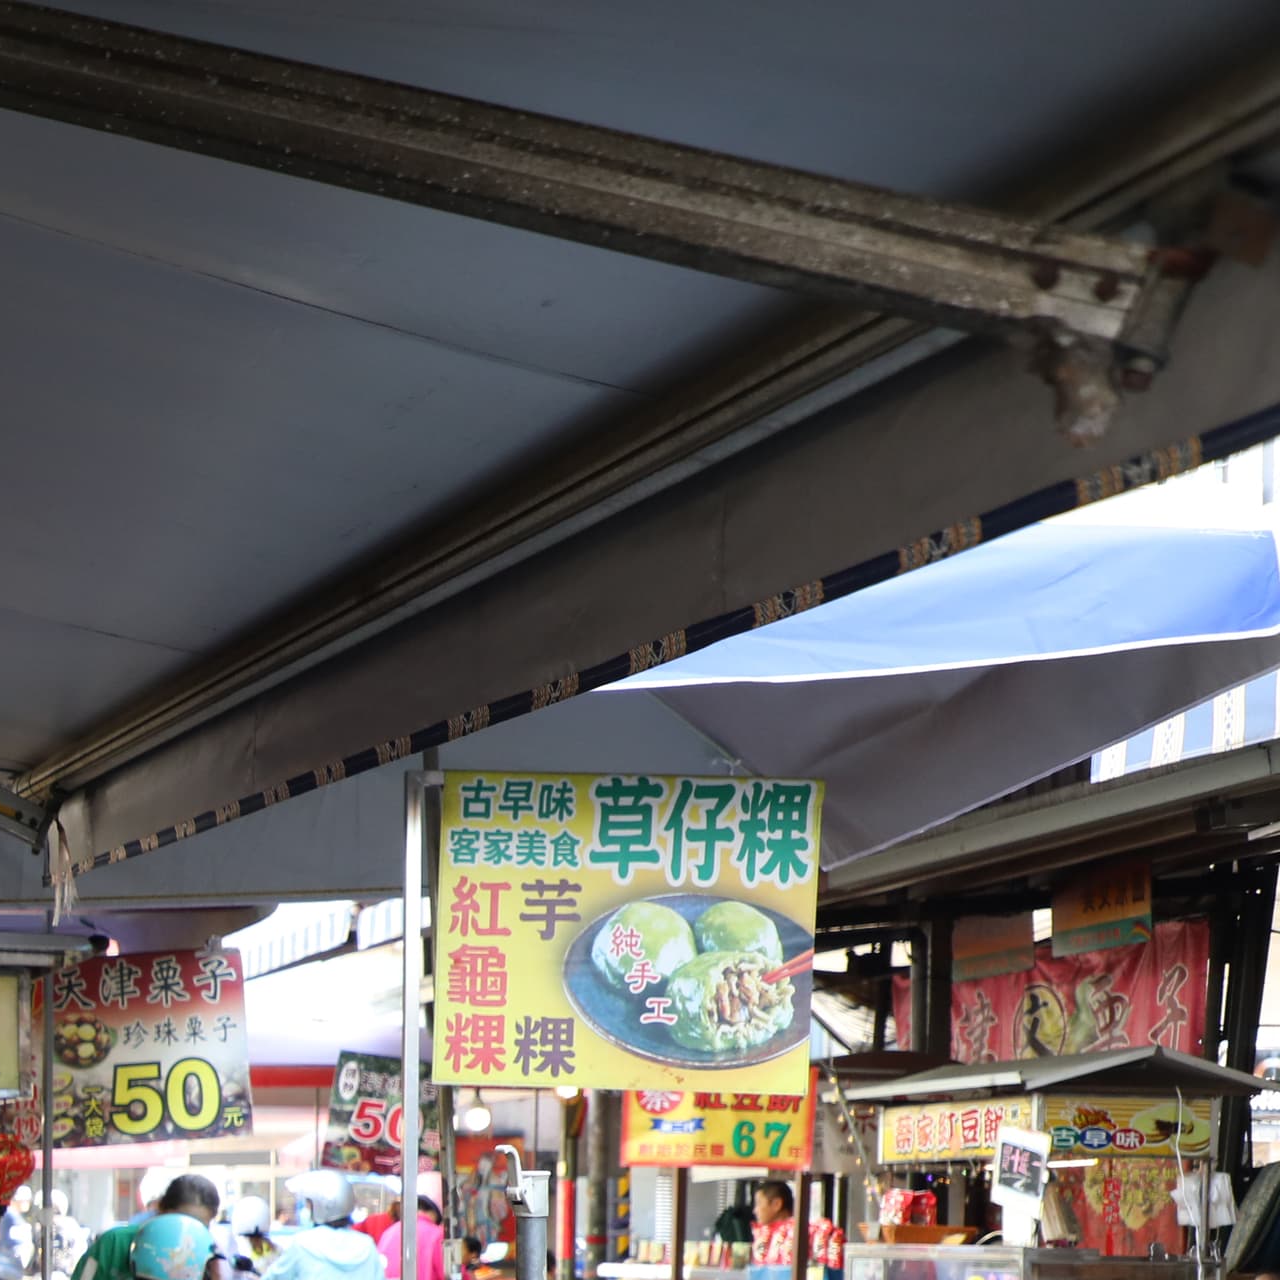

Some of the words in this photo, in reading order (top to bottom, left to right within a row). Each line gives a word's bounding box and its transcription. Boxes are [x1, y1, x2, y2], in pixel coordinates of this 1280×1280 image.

[461, 779, 574, 821] 古早味
[449, 828, 581, 868] 客家美食
[589, 776, 811, 884] 草仔粿
[53, 955, 238, 1010] 天津栗子
[444, 875, 512, 1075] 紅龜粿
[611, 924, 678, 1025] 純手工
[122, 1015, 238, 1051] 珍珠栗子
[109, 1056, 223, 1136] 50
[895, 1104, 1005, 1154] 蔡家紅豆餅
[1052, 1127, 1145, 1150] 古早味
